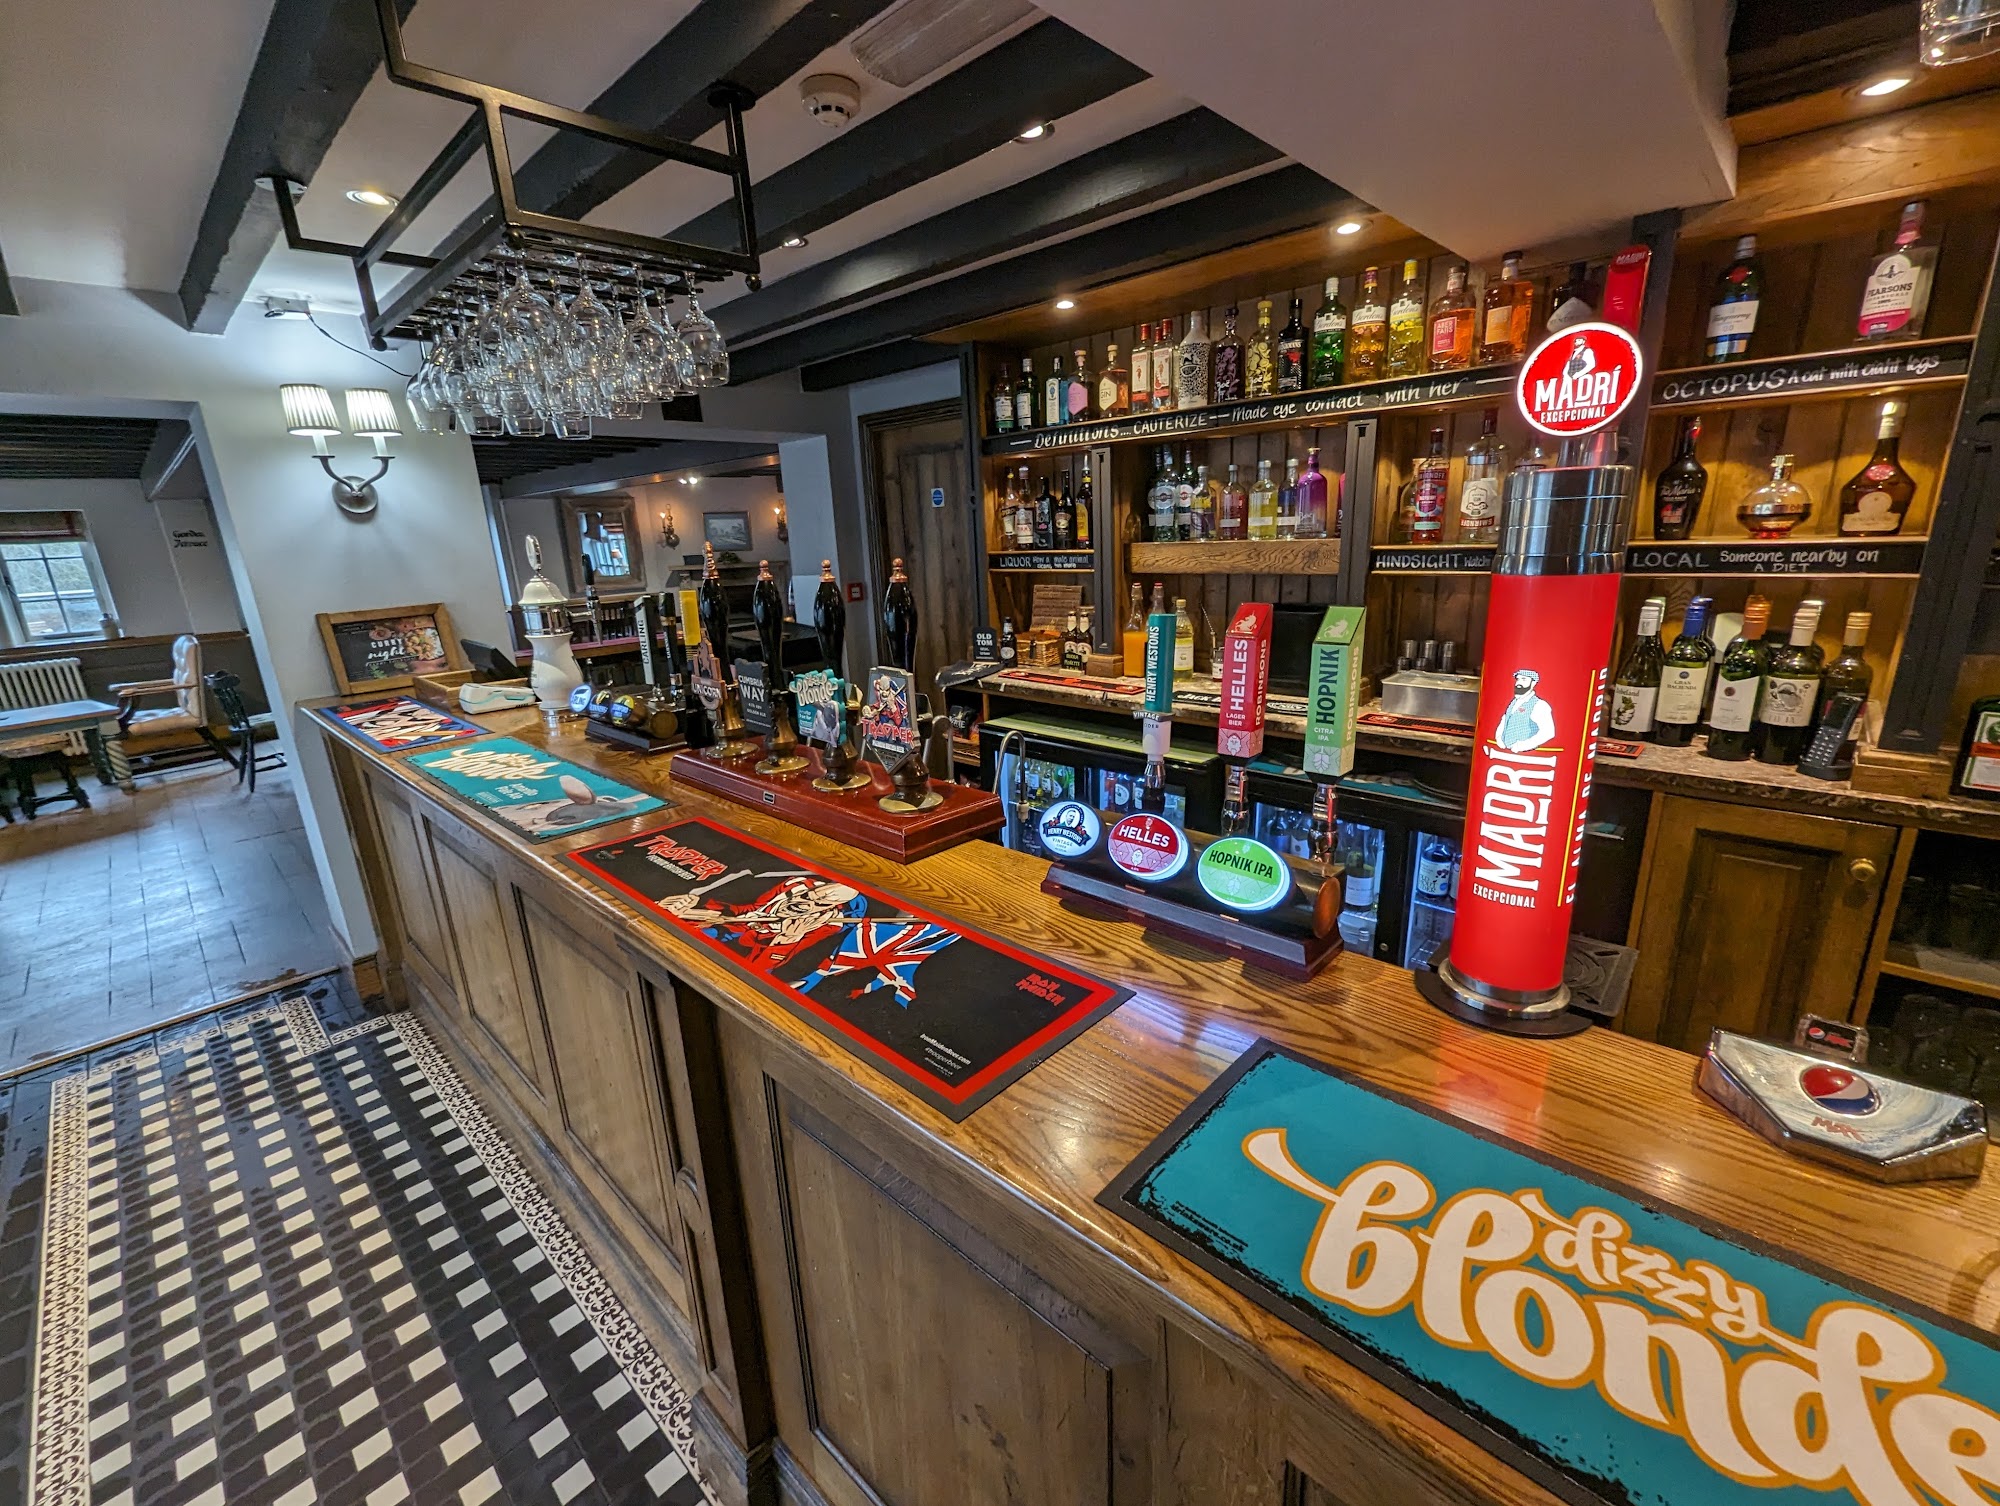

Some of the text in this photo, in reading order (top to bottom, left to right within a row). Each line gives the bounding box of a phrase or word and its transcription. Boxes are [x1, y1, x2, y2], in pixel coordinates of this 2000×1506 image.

[1867, 282, 1913, 298] PEARSONS
[1534, 365, 1622, 411] MADRÍ
[1663, 368, 1787, 400] OCTOPUS
[1801, 366, 1826, 382] cat
[1906, 354, 1941, 376] legs
[1133, 412, 1208, 435] CAUTERIZE
[1232, 405, 1269, 422] Made
[1273, 402, 1297, 419] eye
[1305, 391, 1365, 412] contact
[1384, 385, 1420, 404] with
[1429, 377, 1469, 397] her
[1541, 406, 1606, 423] EXCEPCIONAL
[1000, 556, 1031, 567] LIQUOR
[1376, 553, 1463, 569] HINDSIGHT
[1633, 549, 1879, 568] LOCAL Someone nearby on
[1754, 563, 1809, 572] A DIET
[368, 646, 405, 660] night
[370, 638, 403, 649] CURRY
[639, 618, 651, 665] CARLING
[1146, 626, 1160, 702] HENRY WESTONS
[1230, 639, 1248, 711] HELLES
[692, 683, 722, 699] UNICORN
[738, 674, 764, 688] CUMBRIA
[740, 684, 765, 702] WAY
[789, 671, 838, 706] blonde
[1255, 639, 1267, 726] ROBINSONS
[1315, 648, 1340, 725] HOPNIK
[1346, 646, 1359, 741] ROBINSONS
[1133, 711, 1160, 721] VINTAGE
[1314, 727, 1334, 735] CITRA
[1474, 745, 1557, 892] MADRÍ
[1118, 824, 1170, 848] HELLES
[634, 834, 728, 881] TROOPER
[1208, 849, 1274, 879] HOPNIK IPA
[1473, 882, 1536, 909] EXCEPCIONAL
[1015, 979, 1066, 1007] MAIDEN
[1025, 973, 1060, 992] IRON
[1811, 1116, 1866, 1143] MAX
[1520, 1188, 1818, 1359] dizzy
[1243, 1128, 2000, 1506] blonde
